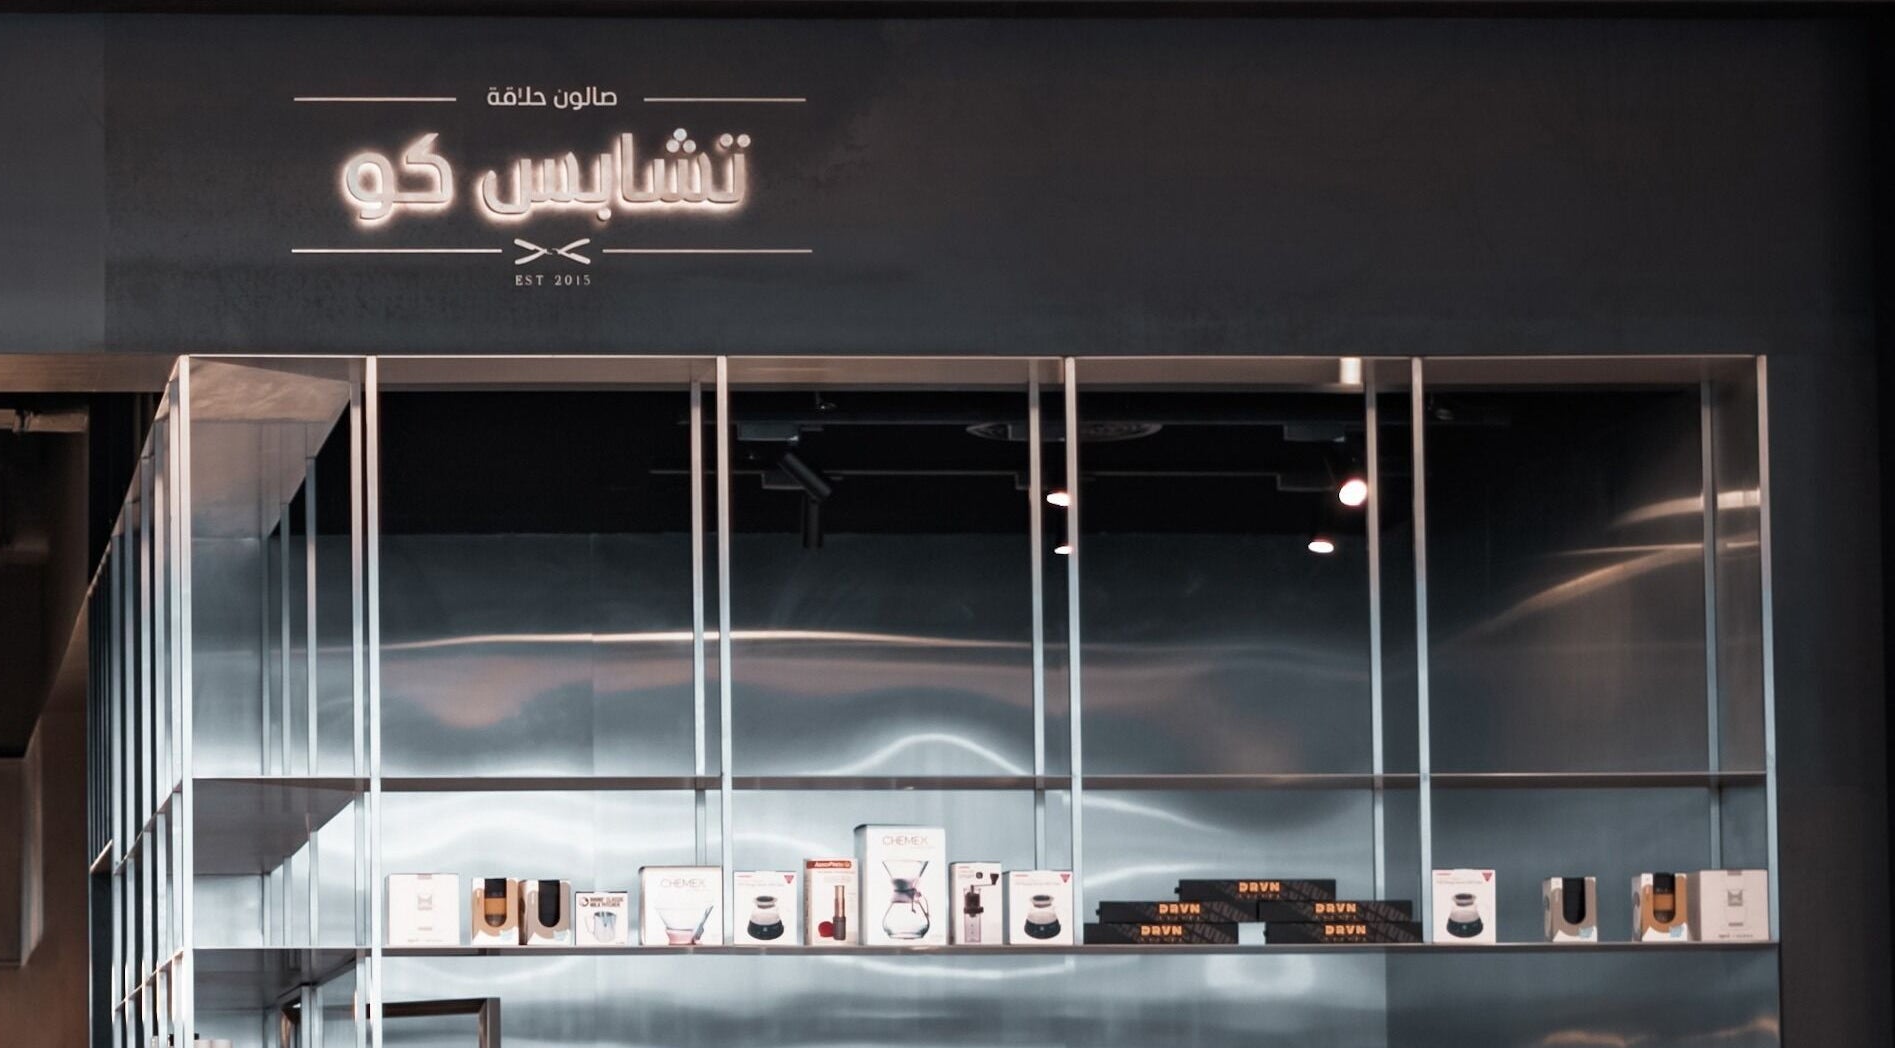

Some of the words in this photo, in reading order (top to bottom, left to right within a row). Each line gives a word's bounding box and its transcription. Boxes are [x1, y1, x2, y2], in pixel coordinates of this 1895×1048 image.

[487, 86, 547, 107] حلاقة
[553, 86, 618, 110] صالون
[344, 132, 454, 224] كو
[479, 127, 752, 222] تشابس
[515, 274, 544, 286] EST
[554, 274, 592, 286] 2015
[1238, 881, 1281, 893] DRVN
[1158, 903, 1201, 915] DRVN
[1315, 903, 1357, 914] DRVN
[1140, 925, 1183, 936] DRVN
[1324, 924, 1367, 936] DRVN
